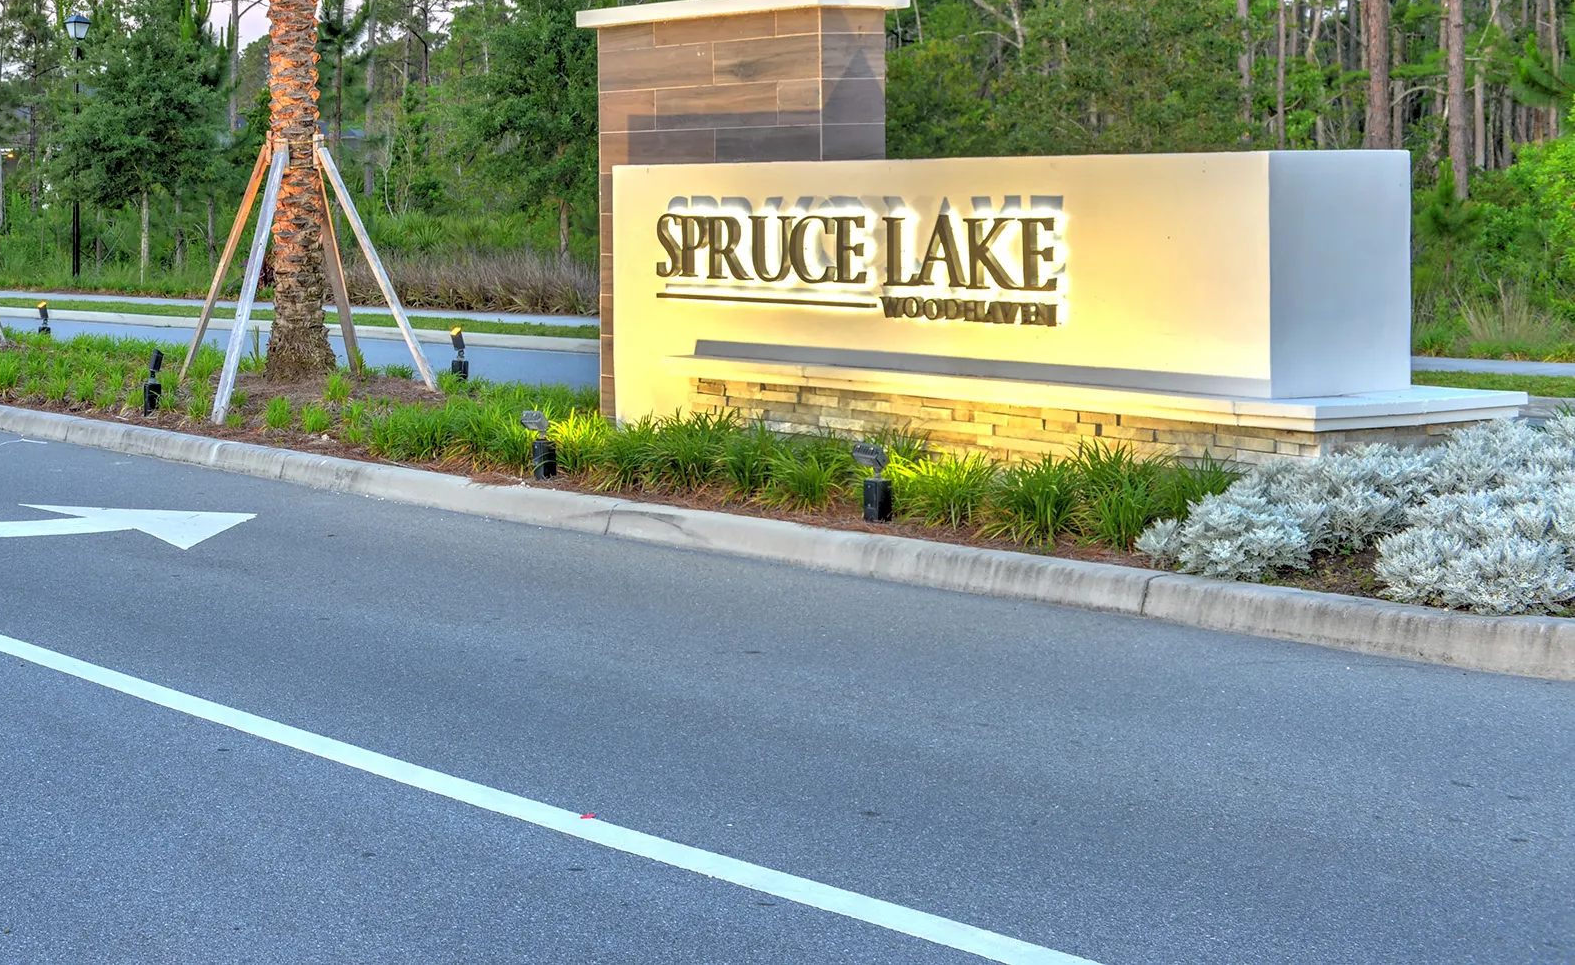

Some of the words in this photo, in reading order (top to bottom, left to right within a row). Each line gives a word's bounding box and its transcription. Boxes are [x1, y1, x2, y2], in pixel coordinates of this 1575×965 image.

[656, 213, 867, 284] SPRUCE
[882, 213, 1058, 292] LAKE
[879, 296, 1058, 327] WOODHAVEN
